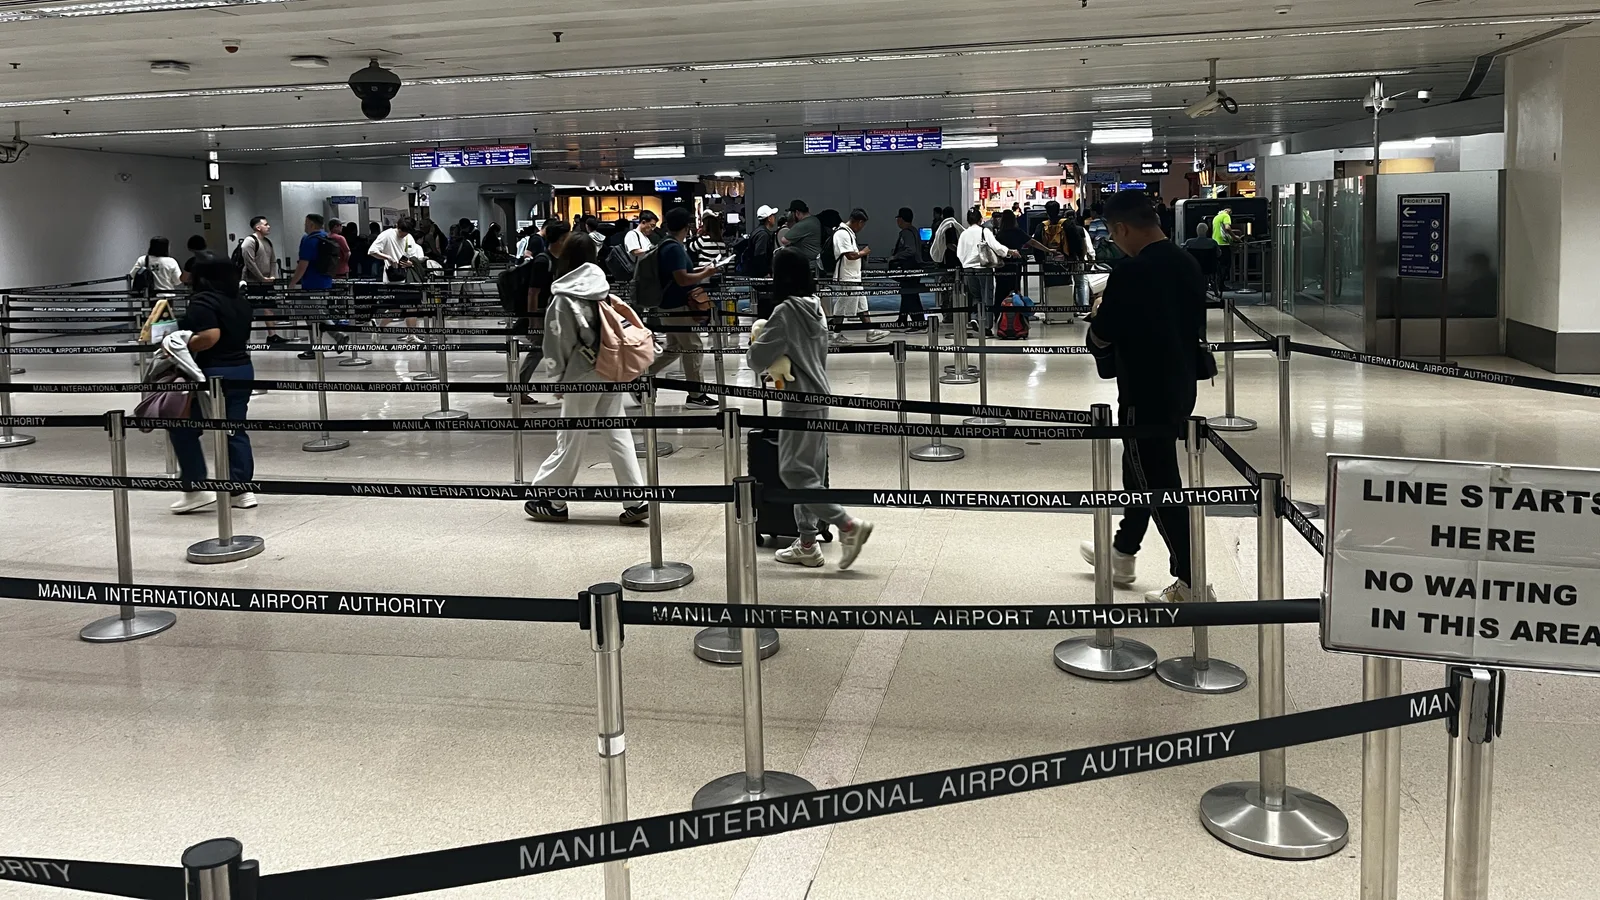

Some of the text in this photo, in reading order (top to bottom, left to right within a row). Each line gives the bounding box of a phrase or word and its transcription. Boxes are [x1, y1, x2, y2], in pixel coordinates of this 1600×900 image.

[586, 183, 633, 191] COACH
[1329, 349, 1516, 385] MANILA INTERNATIONAL AIRPORT AUTHORITY
[32, 382, 199, 392] MANILA INTERNATIONAL AIRPORT AUTHORITY
[276, 382, 450, 392] MANILA INTERNATIONAL AIRPORT AUTHORITY
[506, 383, 650, 392] MANILA INTERNATIONAL AIRPORT
[699, 384, 902, 410] MANILA INTERNATIONAL AIRPORT AUTHORITY
[972, 406, 1012, 417] MANILA
[392, 418, 638, 430] MANILA INTERNATIONAL AIRPORT AUTHORITY
[806, 420, 1085, 438] MANILA INTERNATIONAL AIRPORT AUTHORITY
[31, 475, 126, 488] INTERNATIONAL
[131, 479, 184, 490] AIRPORT
[190, 481, 262, 492] AUTHORITY
[351, 485, 677, 500] MANILA INTERNATIONAL AIRPORT AUTHORITY
[1363, 479, 1448, 506] LINE
[873, 488, 1260, 507] MANILA INTERNATIONAL AIRPORT AUTHORITY
[1431, 524, 1536, 553] HERE
[1364, 569, 1578, 606] NO WAITING
[38, 583, 446, 616] MANILA INTERNATIONAL AIRPORT AUTHORITY
[652, 605, 1180, 626] MANILA INTERNATIONAL AIRPORT AUTHORITY
[1371, 607, 1600, 647] IN THIS AREA
[518, 730, 1237, 872] MANILA INTERNATIONAL AIRPORT AUTHORITY
